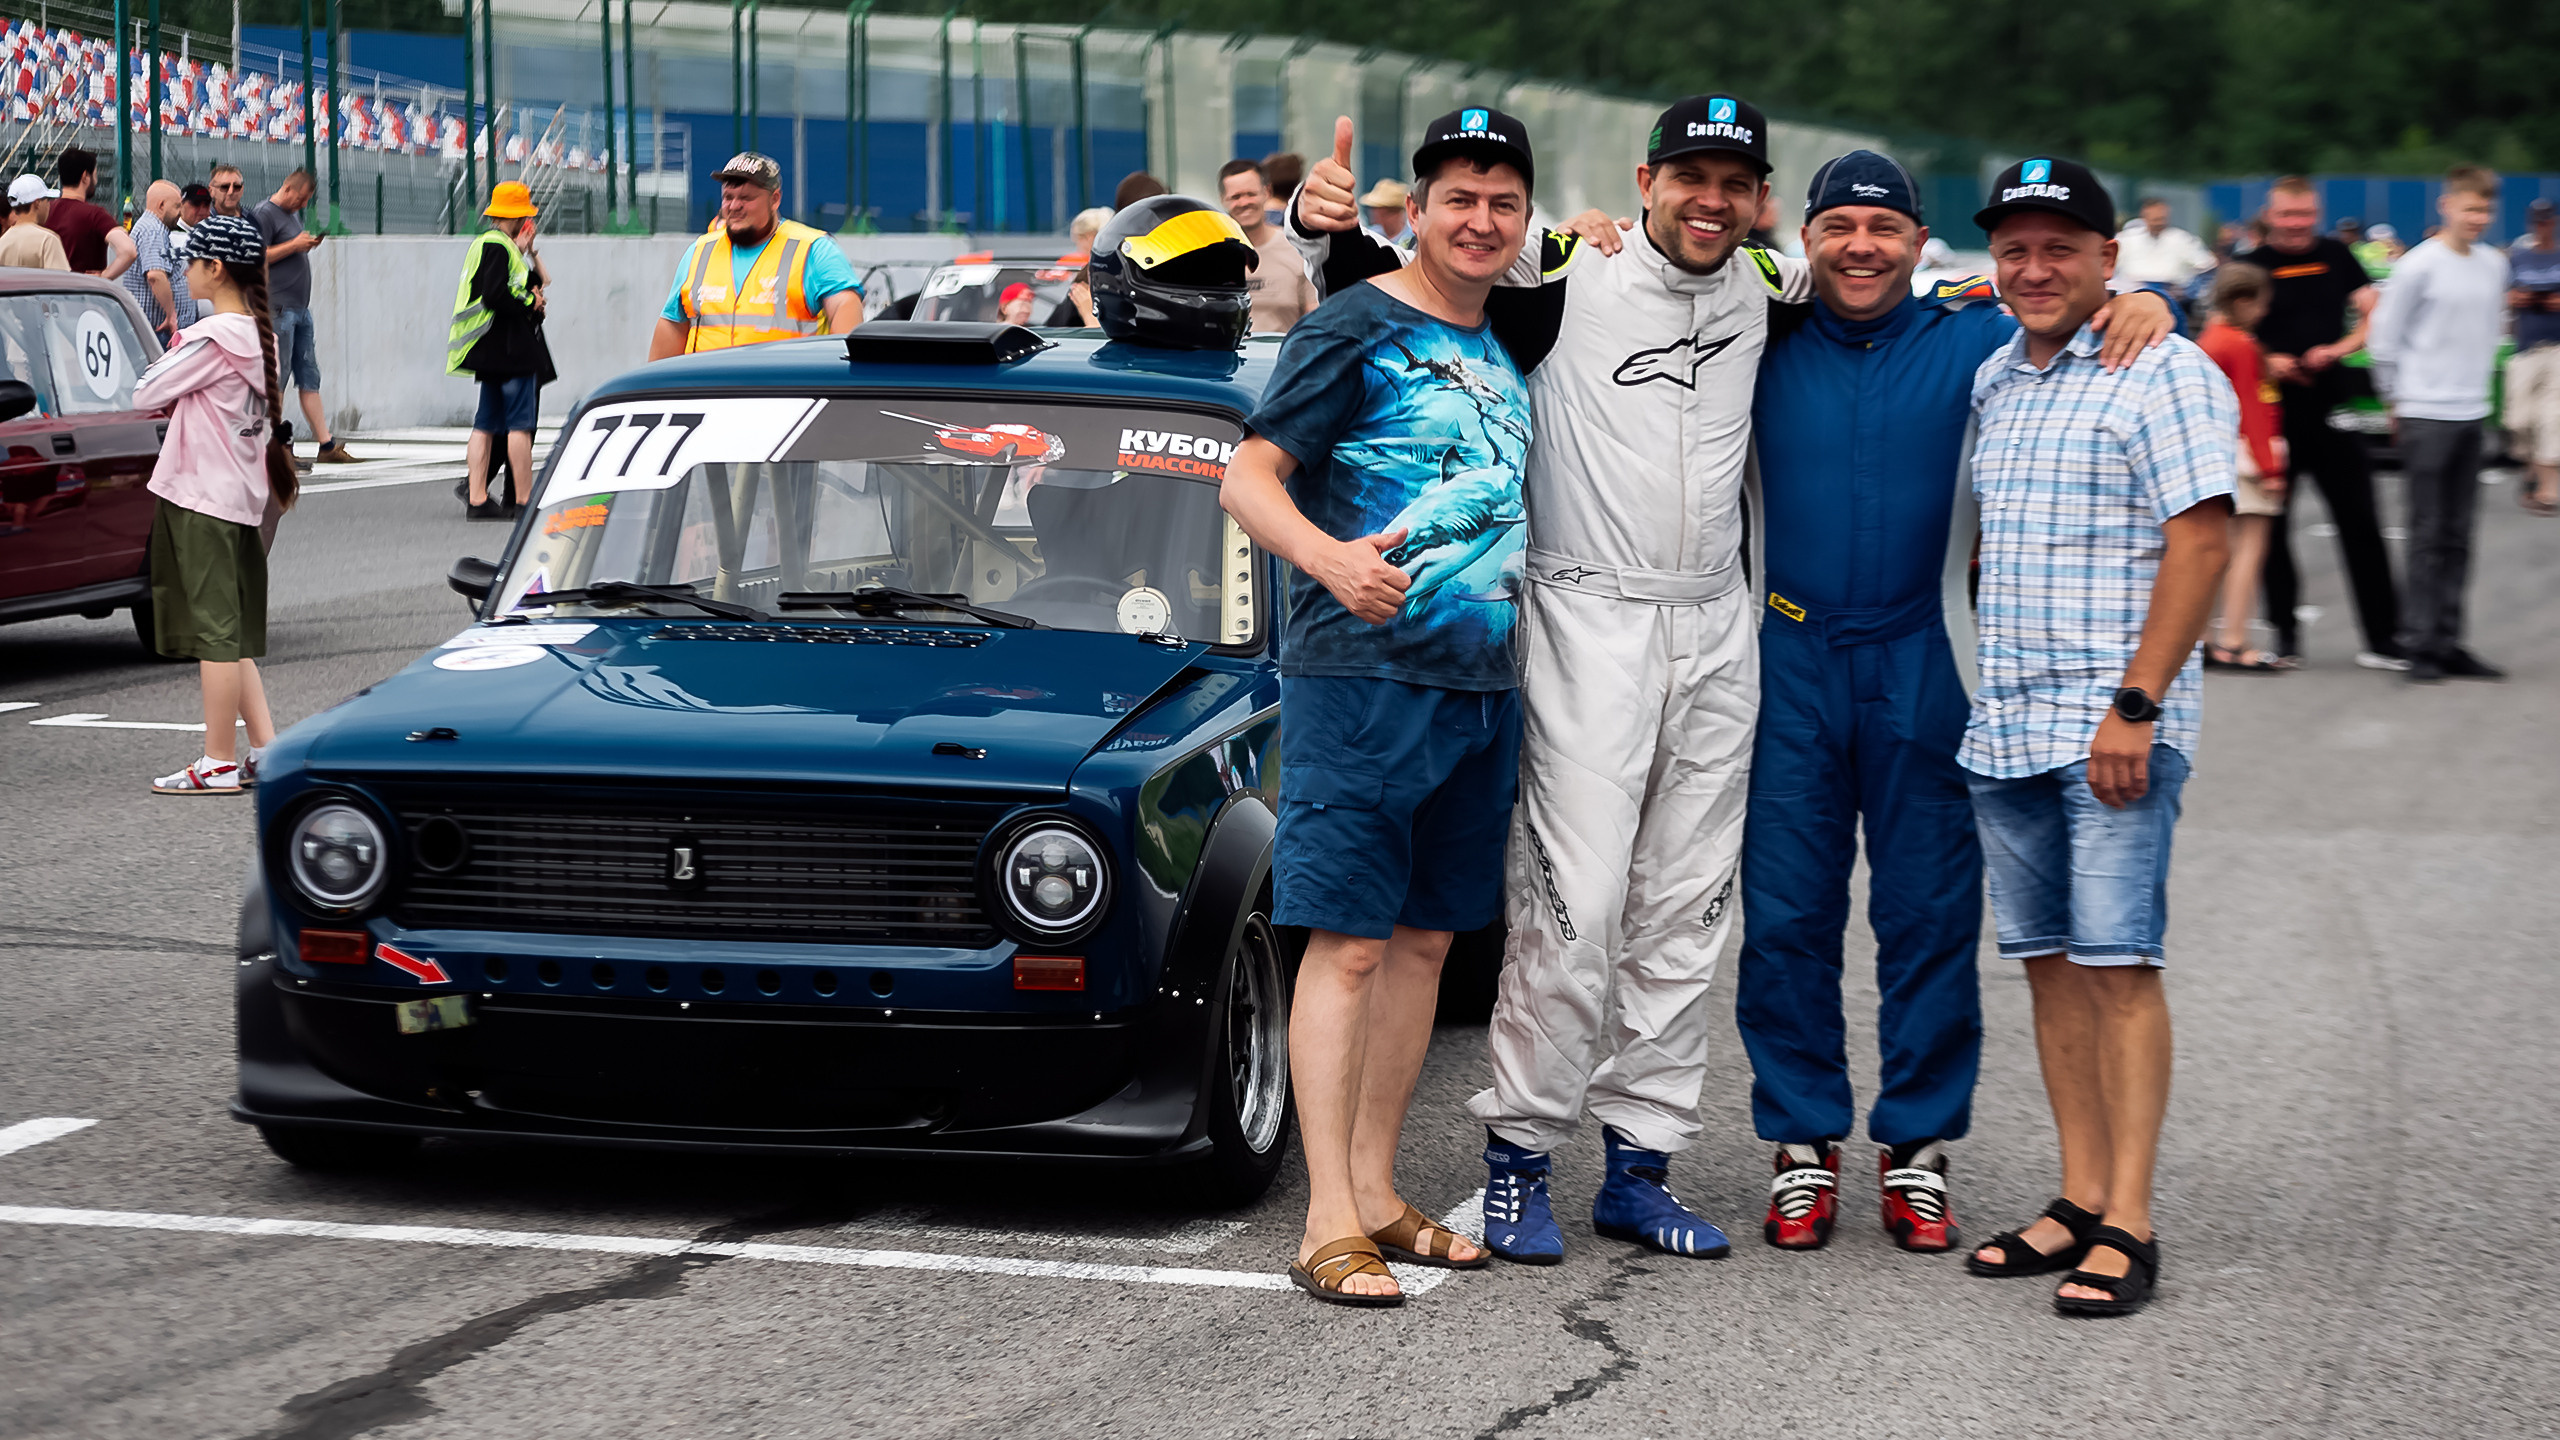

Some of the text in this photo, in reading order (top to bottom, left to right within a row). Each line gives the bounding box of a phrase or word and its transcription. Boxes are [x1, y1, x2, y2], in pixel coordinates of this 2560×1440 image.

[85, 330, 112, 378] 69
[578, 412, 706, 480] 777
[1119, 428, 1240, 465] КУБОК
